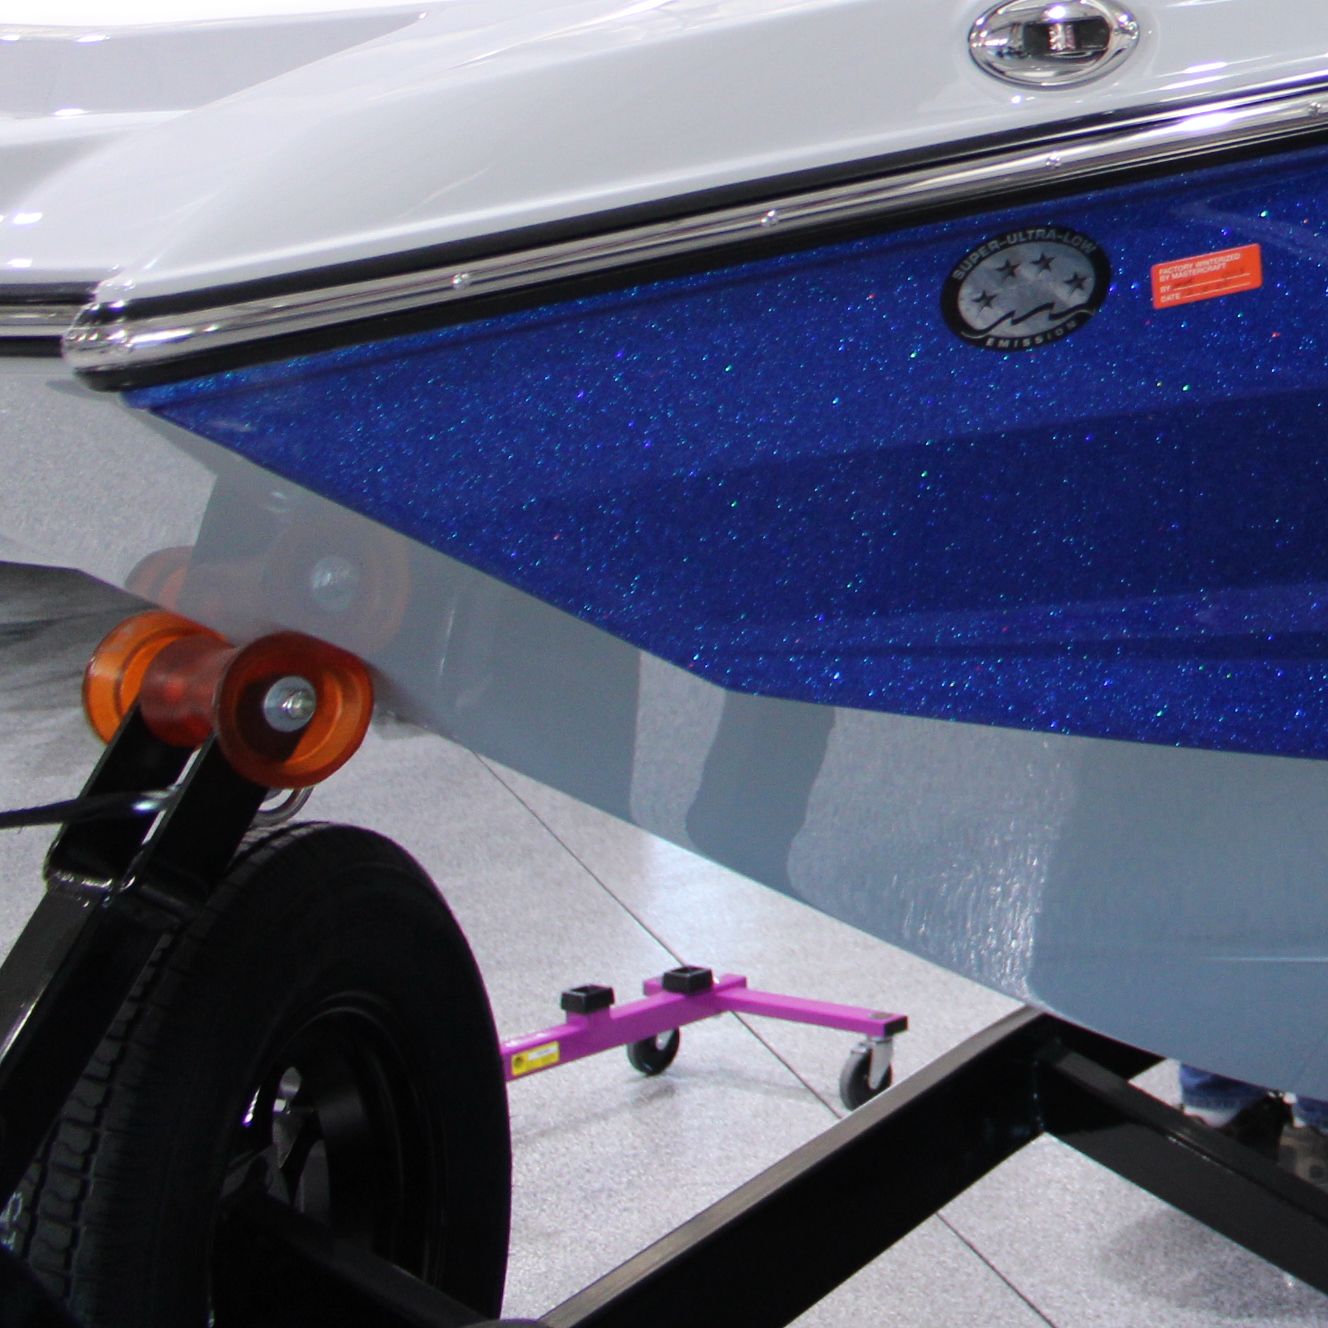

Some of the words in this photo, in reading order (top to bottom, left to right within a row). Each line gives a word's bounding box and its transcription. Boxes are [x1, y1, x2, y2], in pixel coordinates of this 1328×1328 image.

[953, 229, 1097, 280] SUPER-ULTRA-LOW
[1159, 263, 1193, 275] FACTORY
[1159, 275, 1170, 283] BY
[1171, 262, 1227, 279] MASTERCRAFT
[1160, 293, 1181, 303] DATE
[986, 320, 1077, 348] EMISSION
